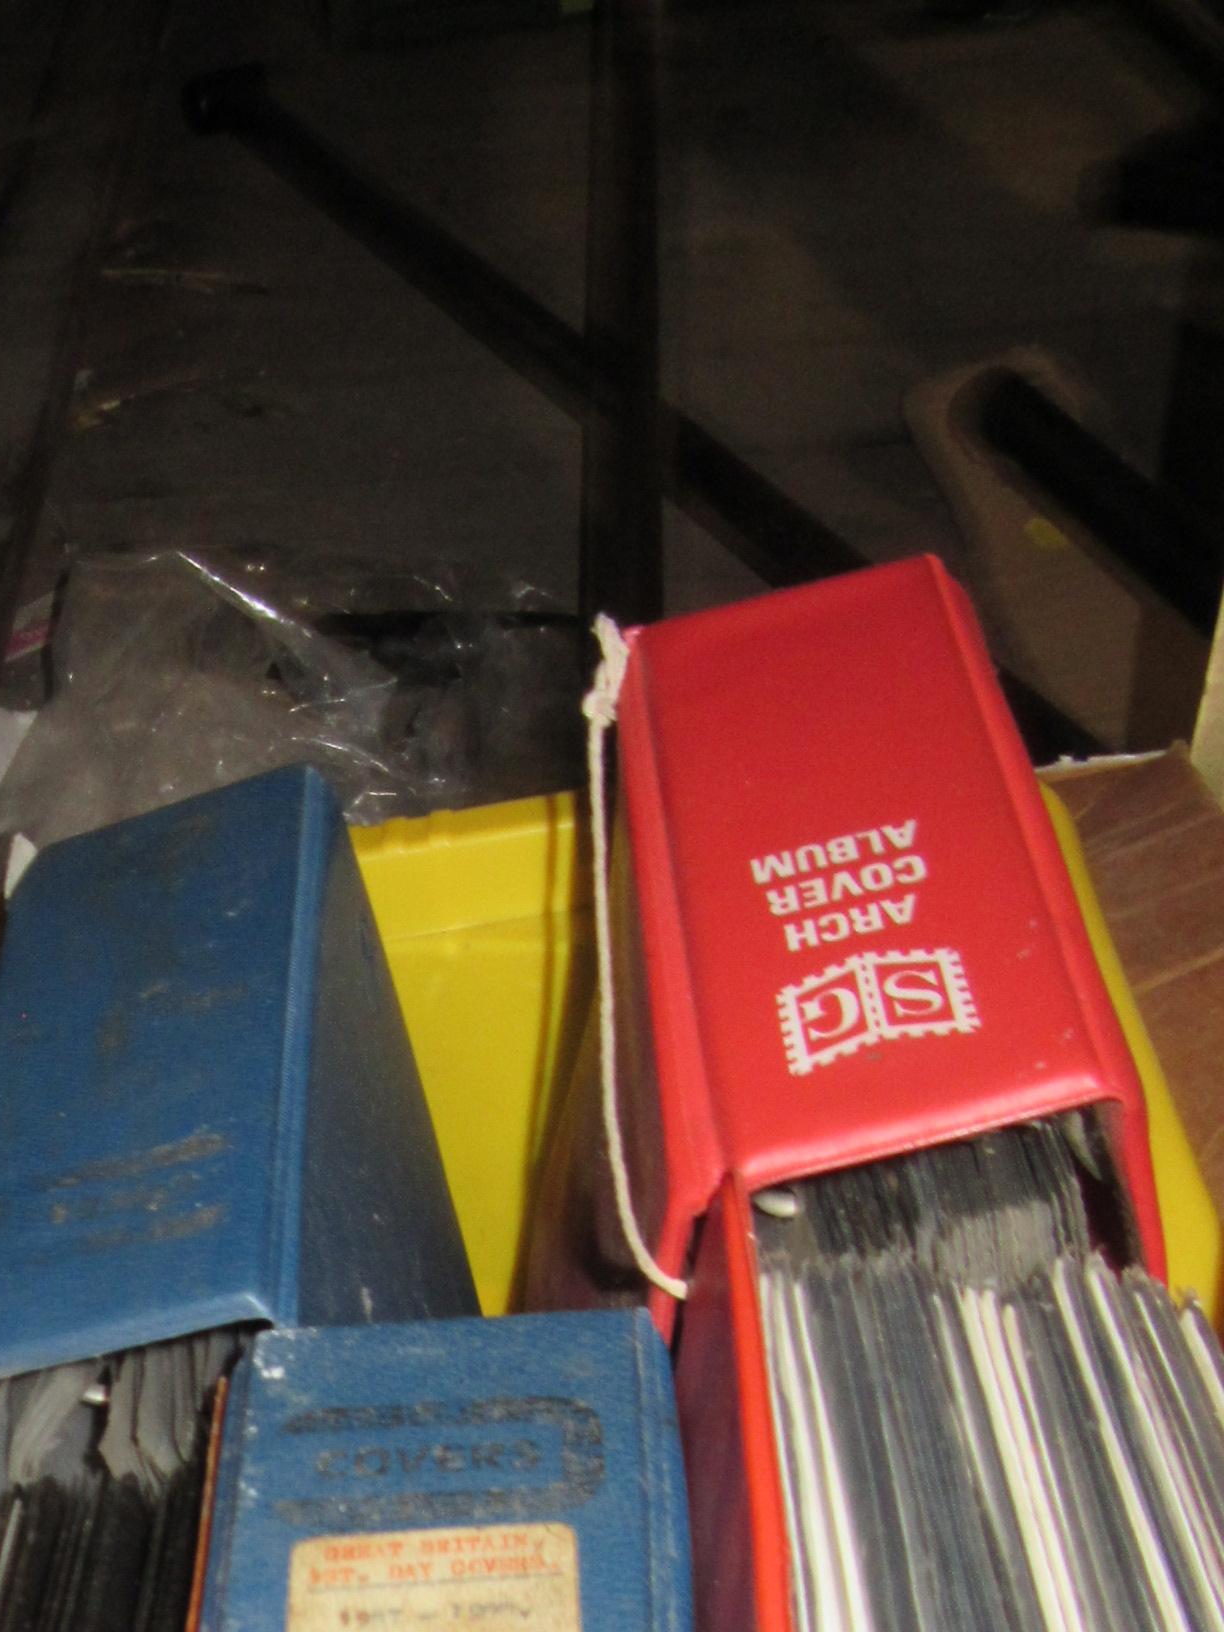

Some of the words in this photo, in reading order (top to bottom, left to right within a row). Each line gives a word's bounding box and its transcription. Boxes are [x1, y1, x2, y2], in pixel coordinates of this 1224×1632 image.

[750, 819, 918, 885] ALBUM
[765, 854, 928, 917] COVER
[782, 893, 917, 953] ARCH
[316, 1439, 543, 1479] COVERS
